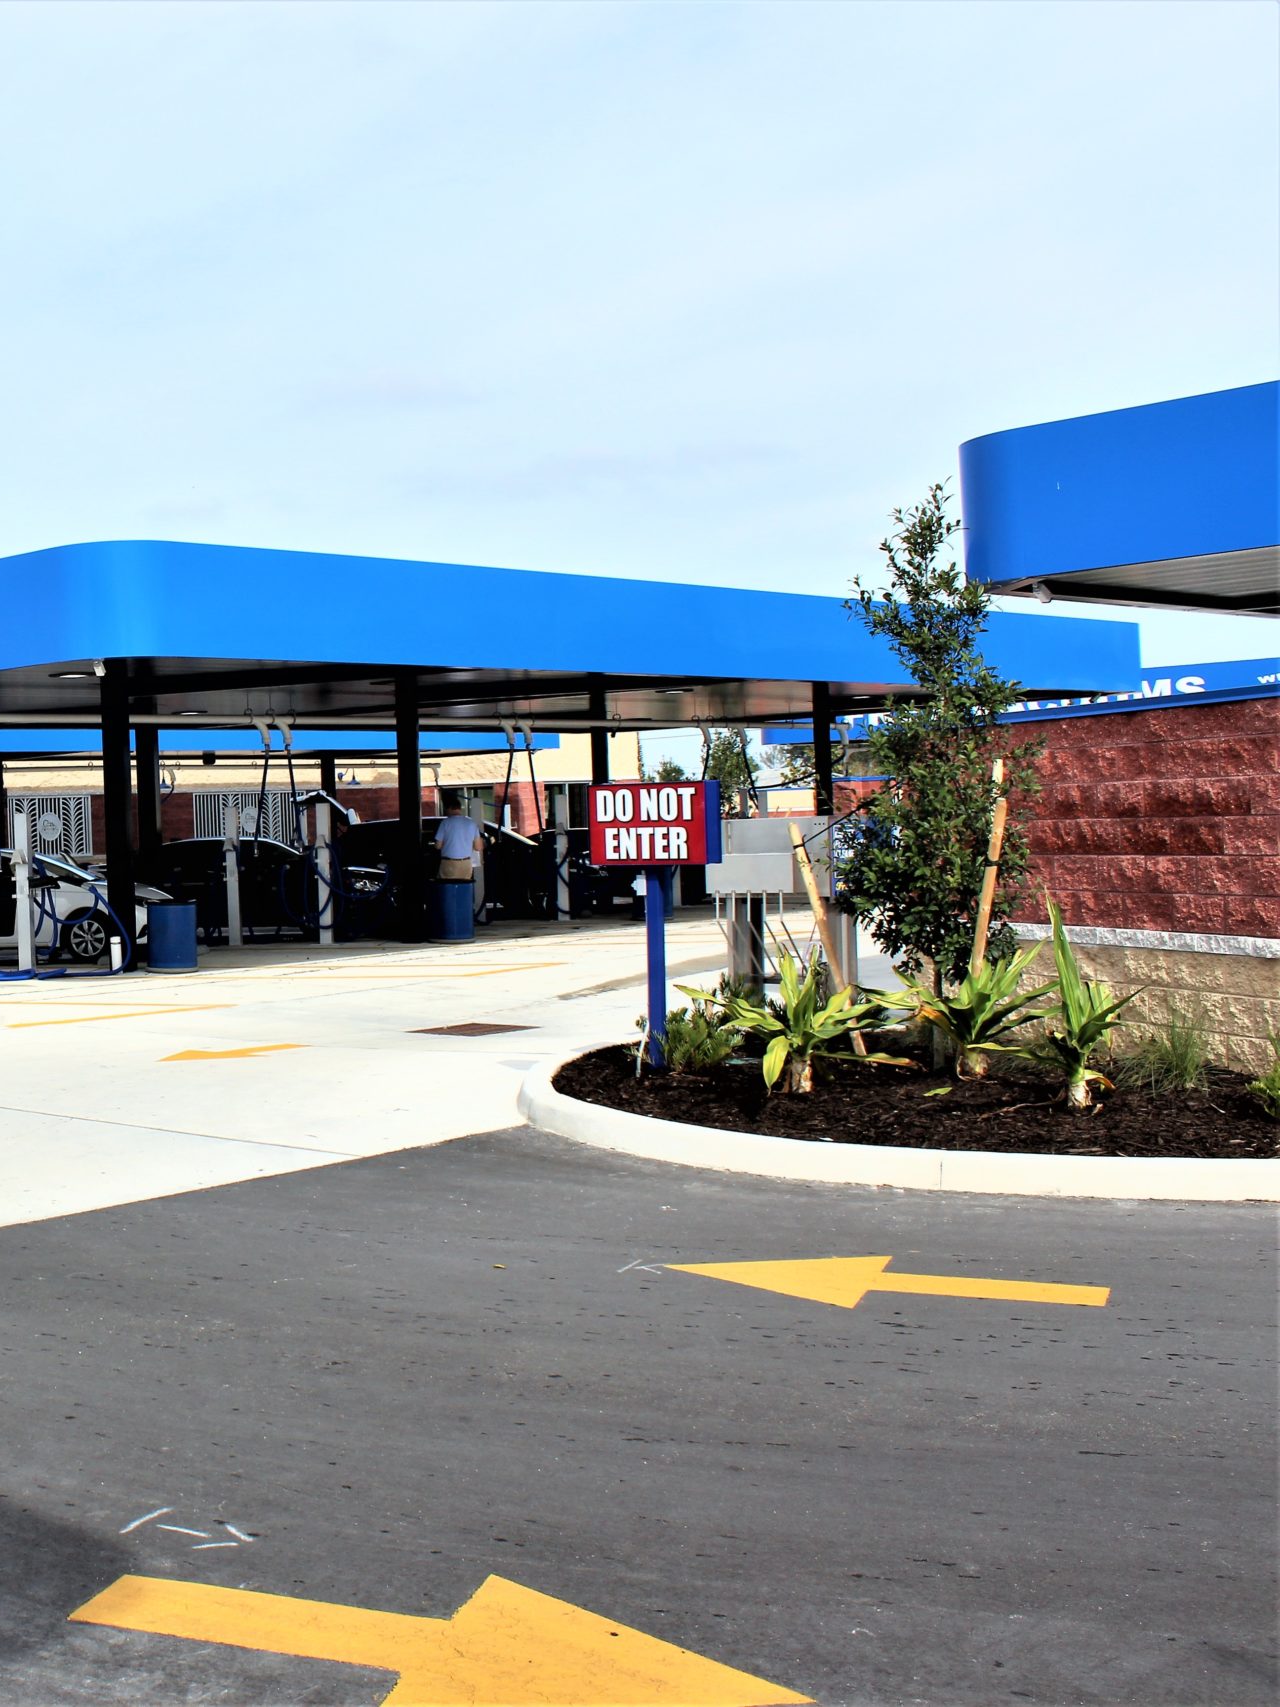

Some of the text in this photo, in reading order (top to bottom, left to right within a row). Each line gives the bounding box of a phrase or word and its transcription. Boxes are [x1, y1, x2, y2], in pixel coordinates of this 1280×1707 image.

[596, 787, 696, 822] DO NOT
[604, 826, 688, 860] ENTER
